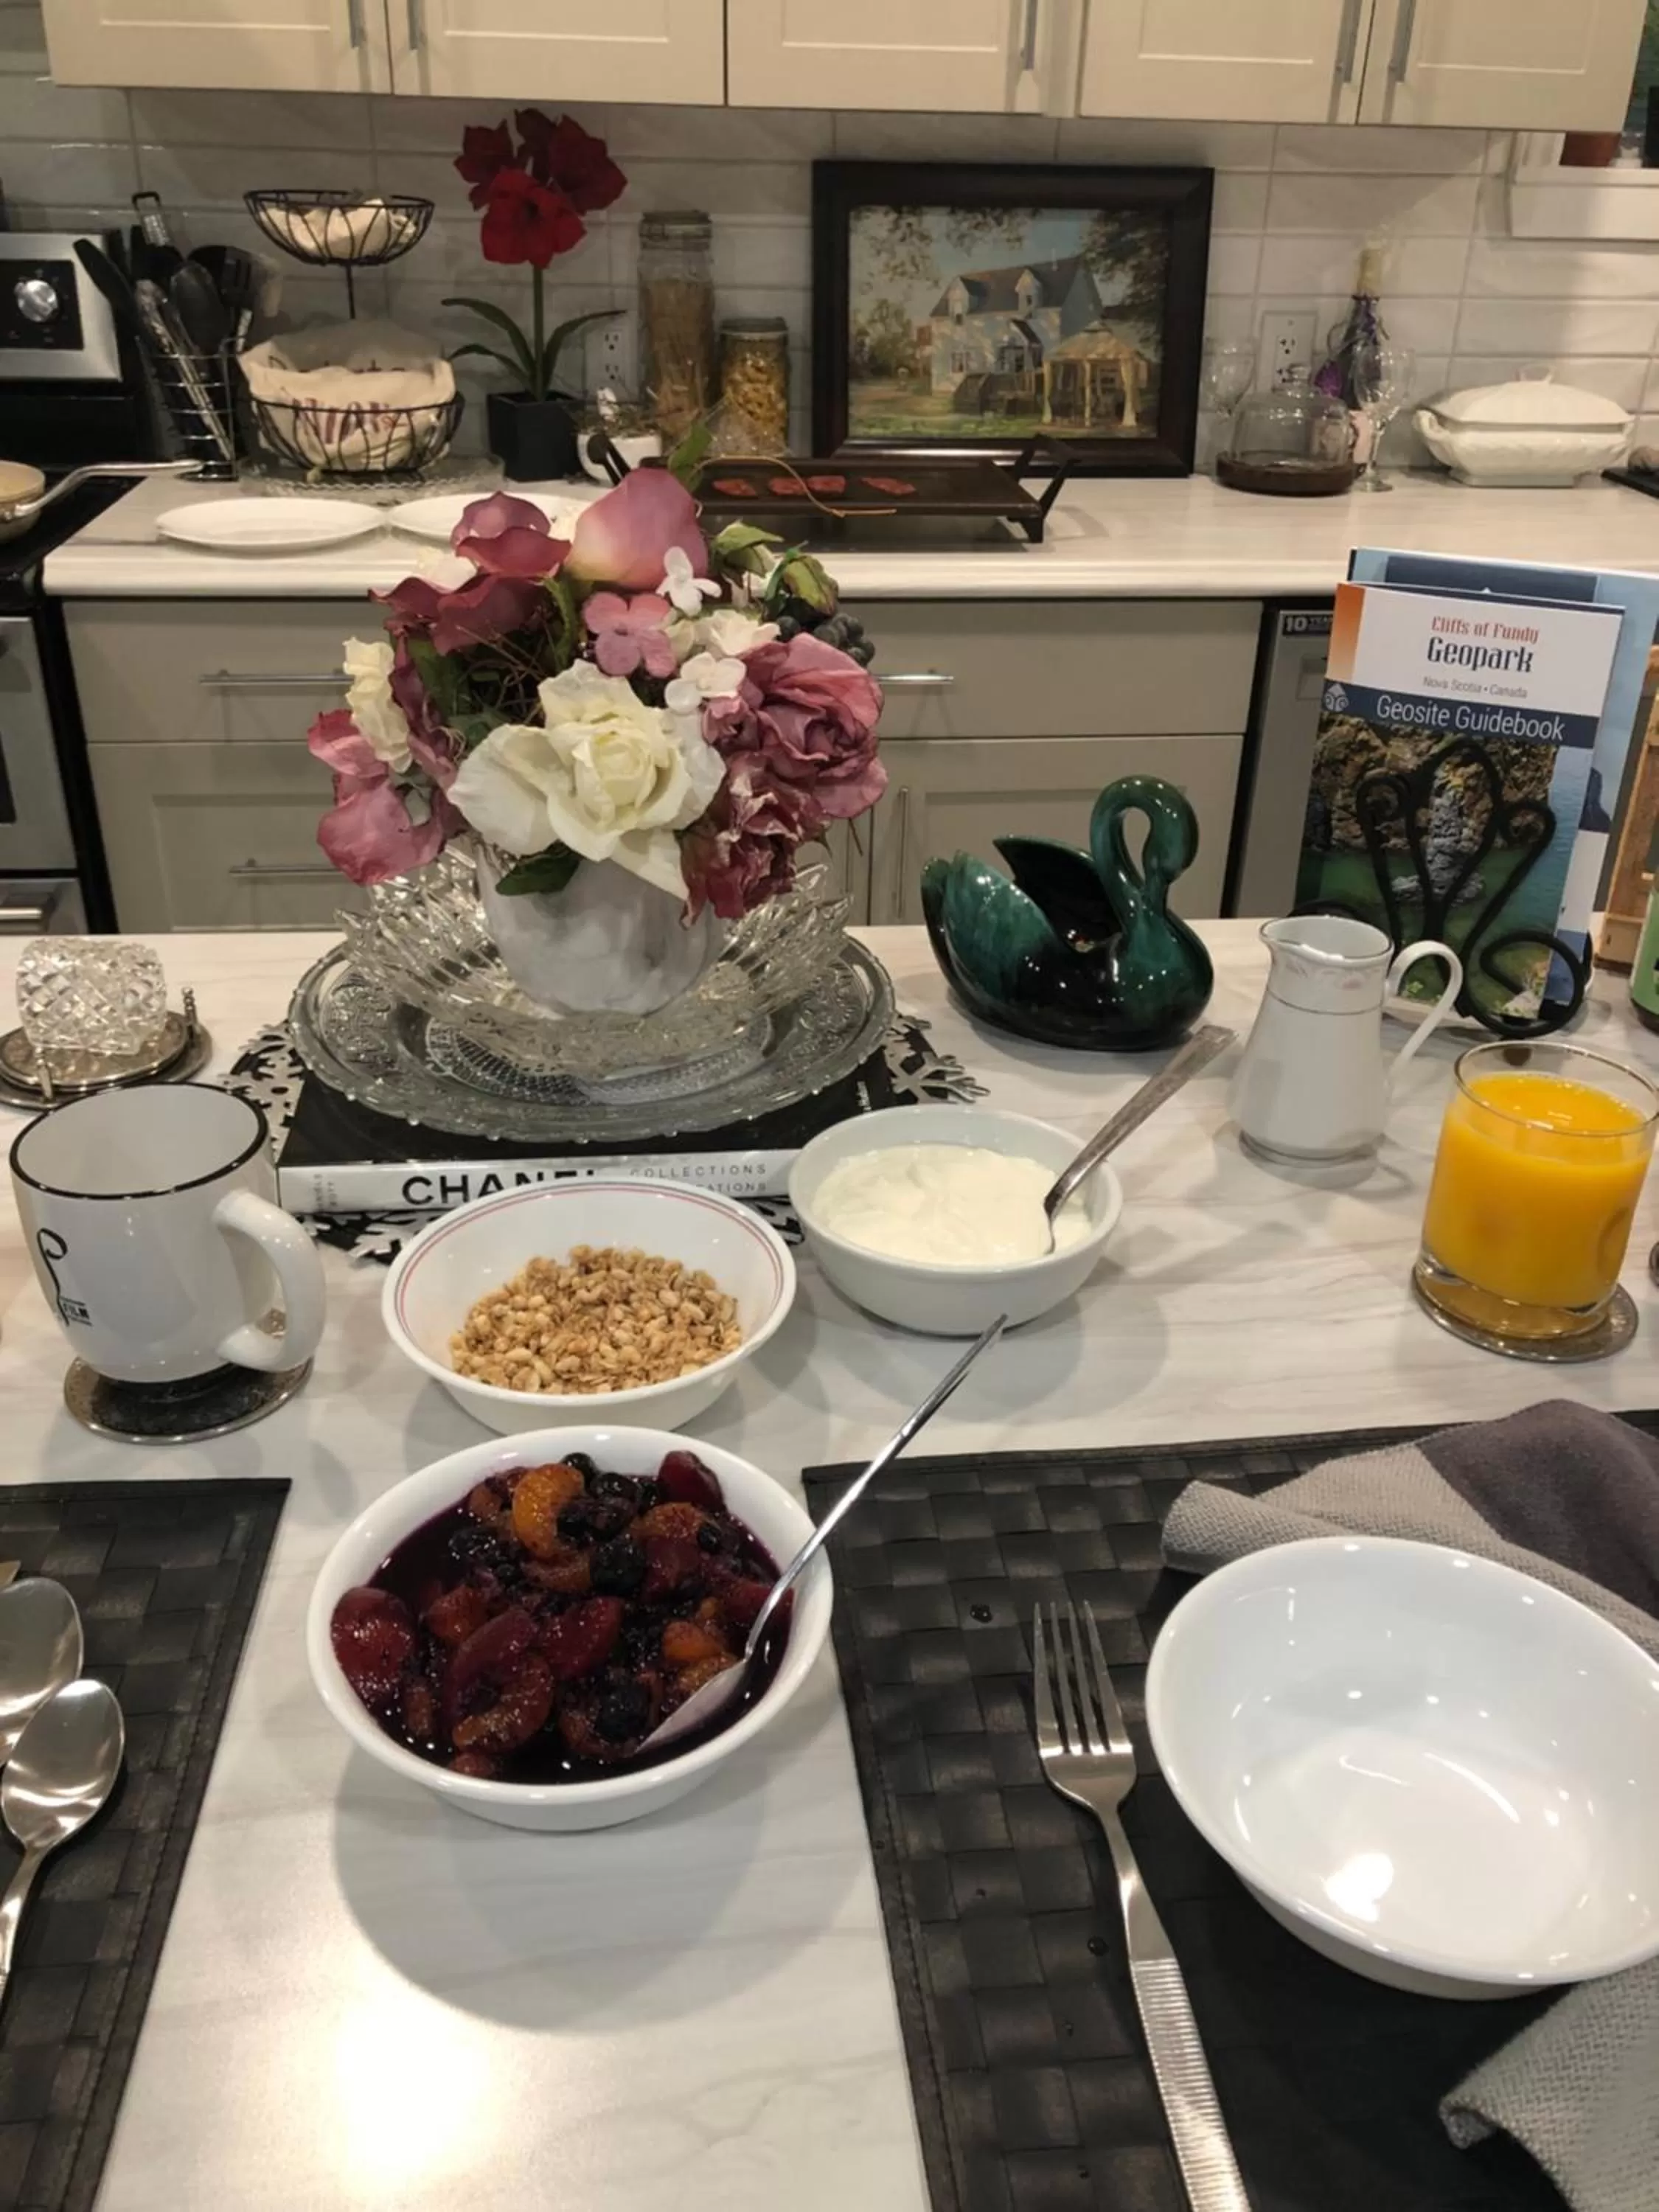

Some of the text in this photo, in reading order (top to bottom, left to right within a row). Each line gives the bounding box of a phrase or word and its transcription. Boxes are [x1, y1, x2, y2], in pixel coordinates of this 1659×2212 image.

[1286, 616, 1308, 632] 10
[1431, 616, 1540, 645] Cliffs of Fundy
[1427, 636, 1534, 672] Geopark
[1423, 676, 1528, 699] Nova Scotia Canada
[1377, 695, 1565, 742] Geosite Guidebook
